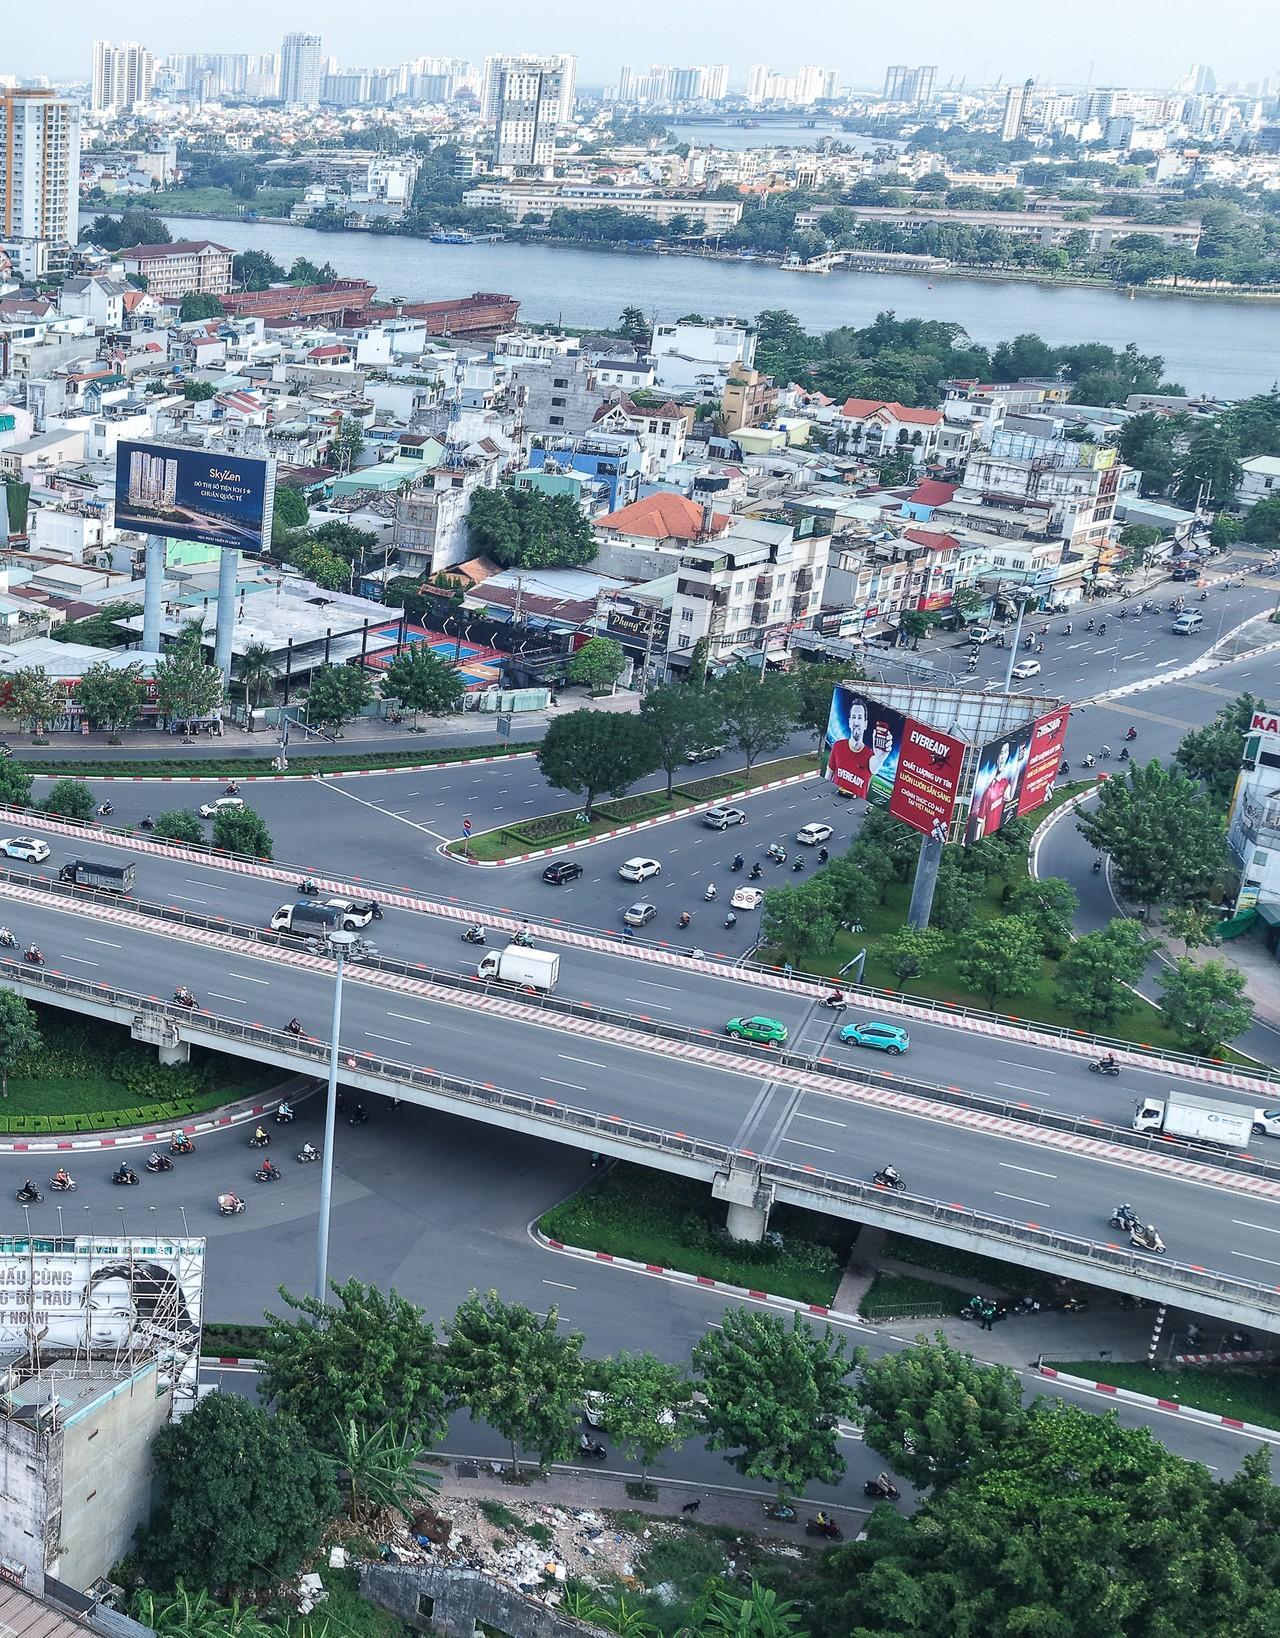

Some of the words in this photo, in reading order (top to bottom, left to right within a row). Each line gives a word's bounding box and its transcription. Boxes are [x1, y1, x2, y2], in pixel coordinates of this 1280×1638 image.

[910, 731, 951, 758] EVEREADY
[837, 768, 864, 789] EVEREADY
[899, 772, 914, 785] LUÔN
[913, 778, 927, 791] LUÔN
[902, 760, 917, 772] CHẤT
[916, 766, 934, 780] LƯỢNG
[934, 774, 943, 784] UY
[943, 777, 953, 789] TÍN
[32, 1267, 73, 1286] CÙNG
